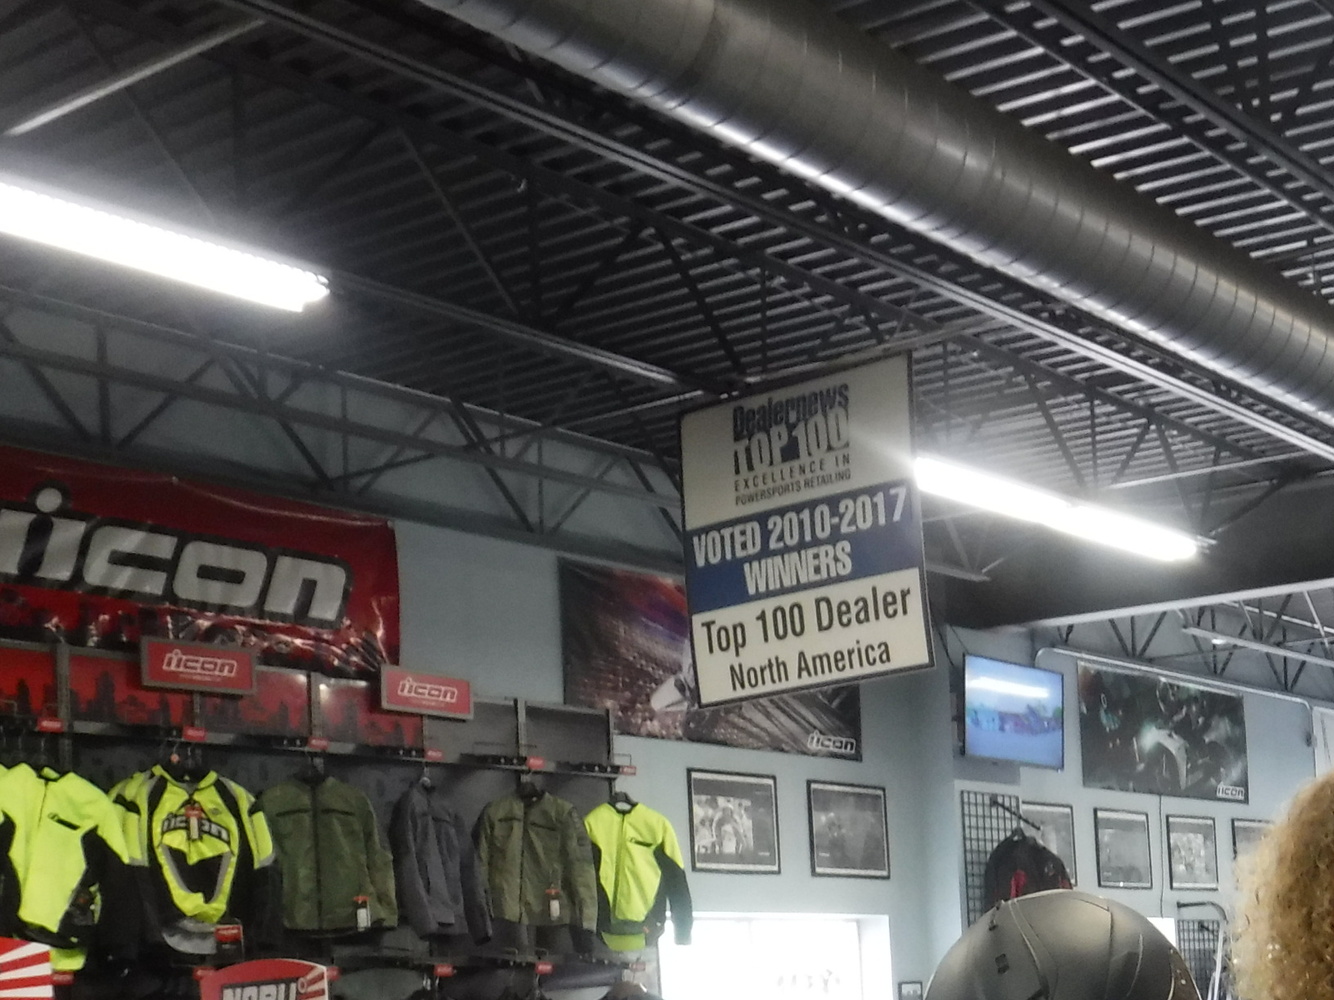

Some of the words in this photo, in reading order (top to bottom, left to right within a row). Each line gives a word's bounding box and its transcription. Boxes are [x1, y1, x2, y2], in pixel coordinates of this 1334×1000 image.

[733, 383, 849, 442] Dealernews
[733, 424, 789, 475] TOP
[791, 406, 850, 461] 100
[734, 458, 825, 492] EXCELLENCE
[834, 453, 850, 468] IN
[735, 480, 802, 506] POWERSPORTS
[803, 468, 851, 489] RETAILING
[692, 523, 761, 567] VOTED
[767, 487, 908, 550] 2010-2017
[743, 540, 853, 595] WINNERS
[701, 620, 747, 656] Top
[756, 602, 806, 644] 100
[815, 586, 911, 632] Dealer
[729, 653, 790, 692] North
[797, 640, 891, 679] America
